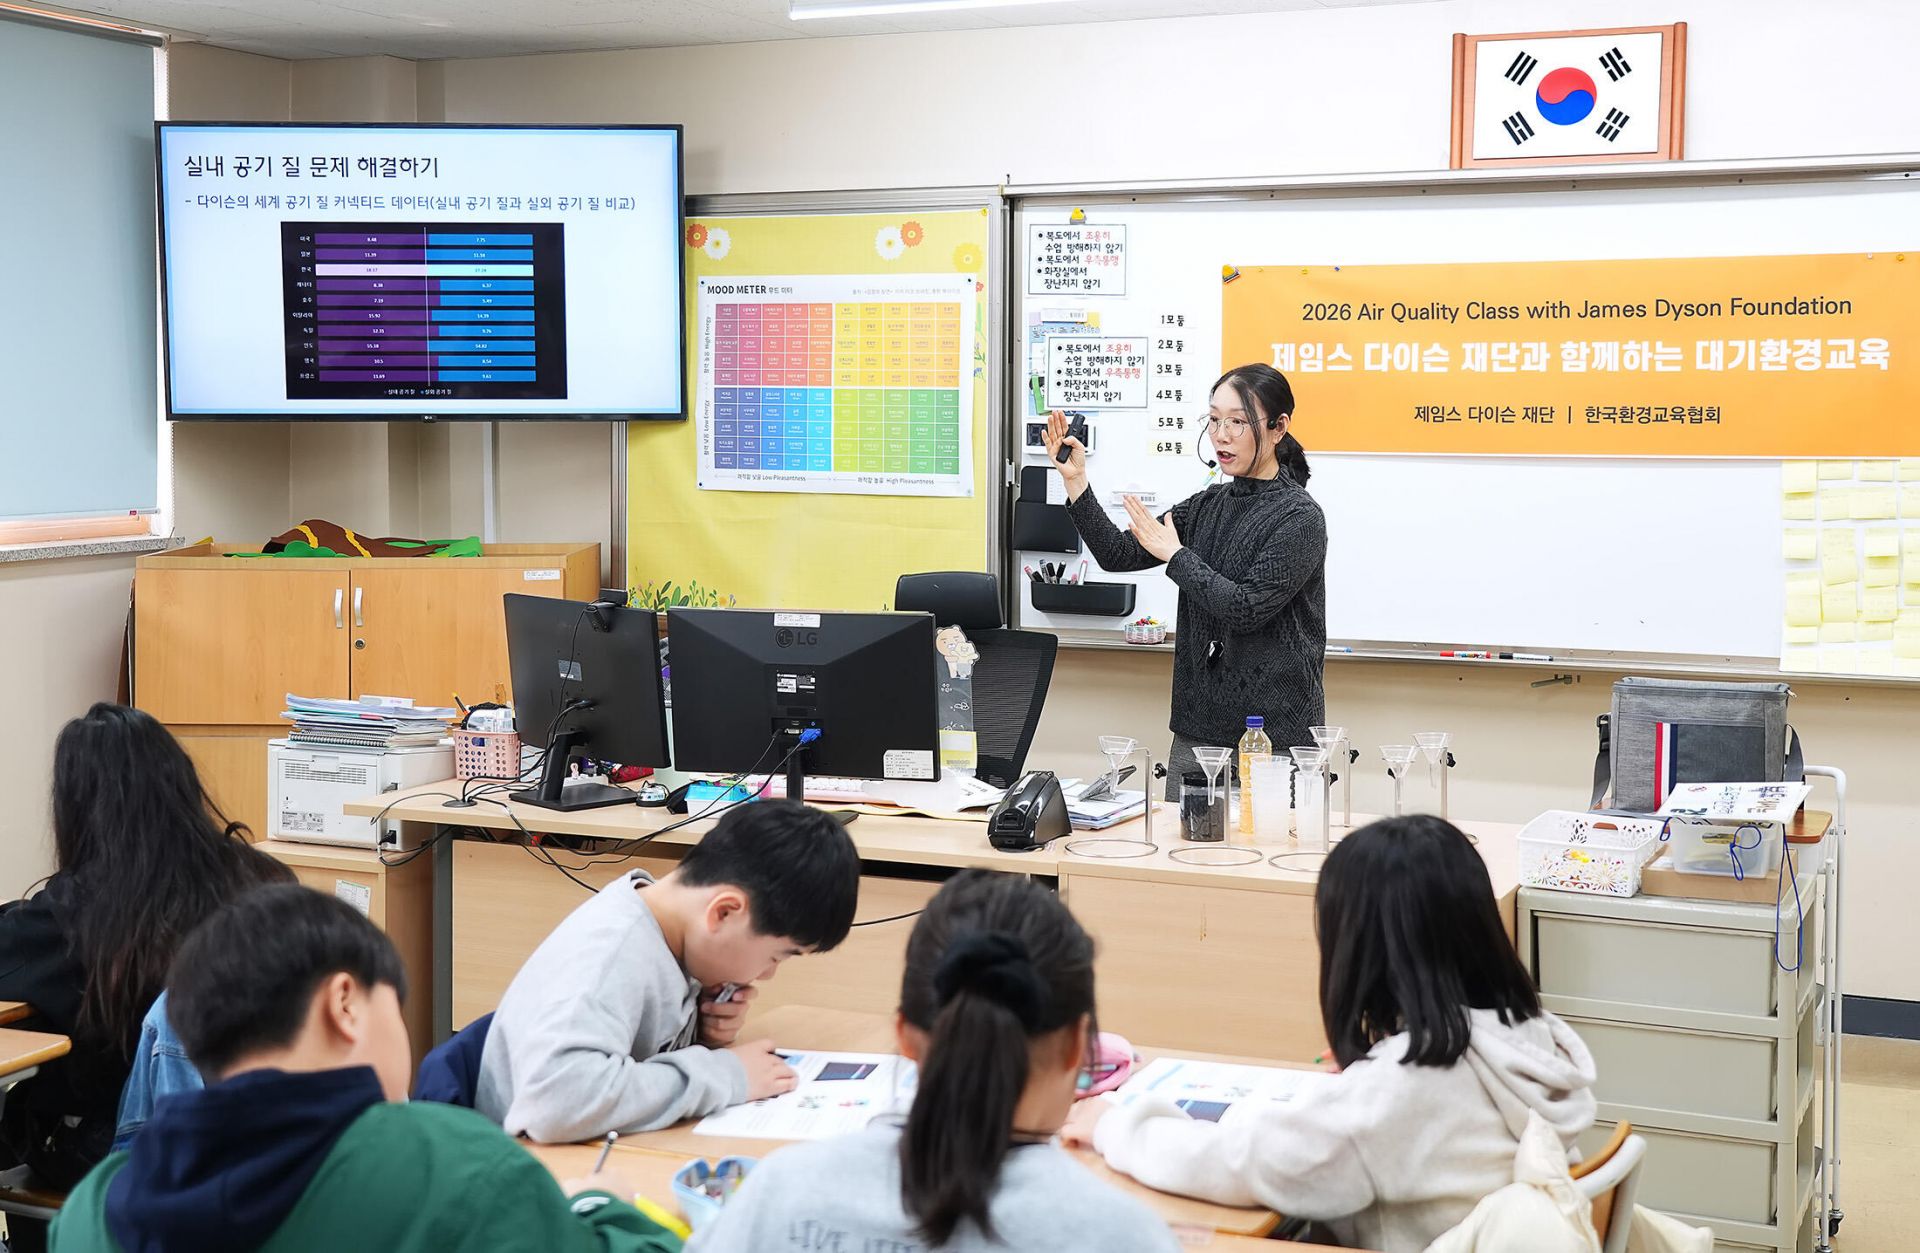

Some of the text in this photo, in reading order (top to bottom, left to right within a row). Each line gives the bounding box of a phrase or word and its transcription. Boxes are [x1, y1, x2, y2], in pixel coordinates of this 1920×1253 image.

[184, 155, 438, 179] 실내 공기 질 문제 해결하기
[198, 194, 249, 210] 다이슨의
[254, 195, 280, 209] 세계
[286, 195, 310, 210] 공기
[316, 195, 328, 210] 질
[334, 195, 386, 210] 커넥티드
[392, 195, 460, 210] 데이터(실내
[466, 196, 490, 210] 공기
[496, 196, 522, 210] 질과
[528, 196, 552, 210] 실외
[558, 196, 582, 210] 공기
[588, 197, 600, 210] 질
[606, 196, 636, 210] 비교)
[1046, 230, 1110, 242] 복도에서 조용히
[1044, 242, 1122, 254] 수업 방해하지 않기
[1046, 254, 1119, 266] 복도에서 우측통행
[1044, 266, 1088, 278] 화장실에서
[708, 286, 734, 294] MOOD
[736, 285, 766, 294] METER
[1044, 278, 1100, 290] 장난치지 않기
[1302, 296, 1852, 324] 2026 Air Quality Class with James Dyson Foundation
[1066, 344, 1132, 354] 복도에서 조용히
[1270, 338, 1890, 372] 제임스 다이슨 재단과 함께하는 대기환경교육
[1064, 356, 1144, 366] 수업 방해하지 않기
[1064, 366, 1140, 378] 복도에서 우측통행
[1064, 380, 1108, 390] 화장실에서
[1064, 392, 1122, 402] 장난치지 않기
[1414, 406, 1462, 423] 제임스
[1468, 406, 1516, 424] 다이슨
[1522, 406, 1556, 424] 재단
[1586, 406, 1720, 424] 한국환경교육협회
[797, 632, 818, 645] LG
